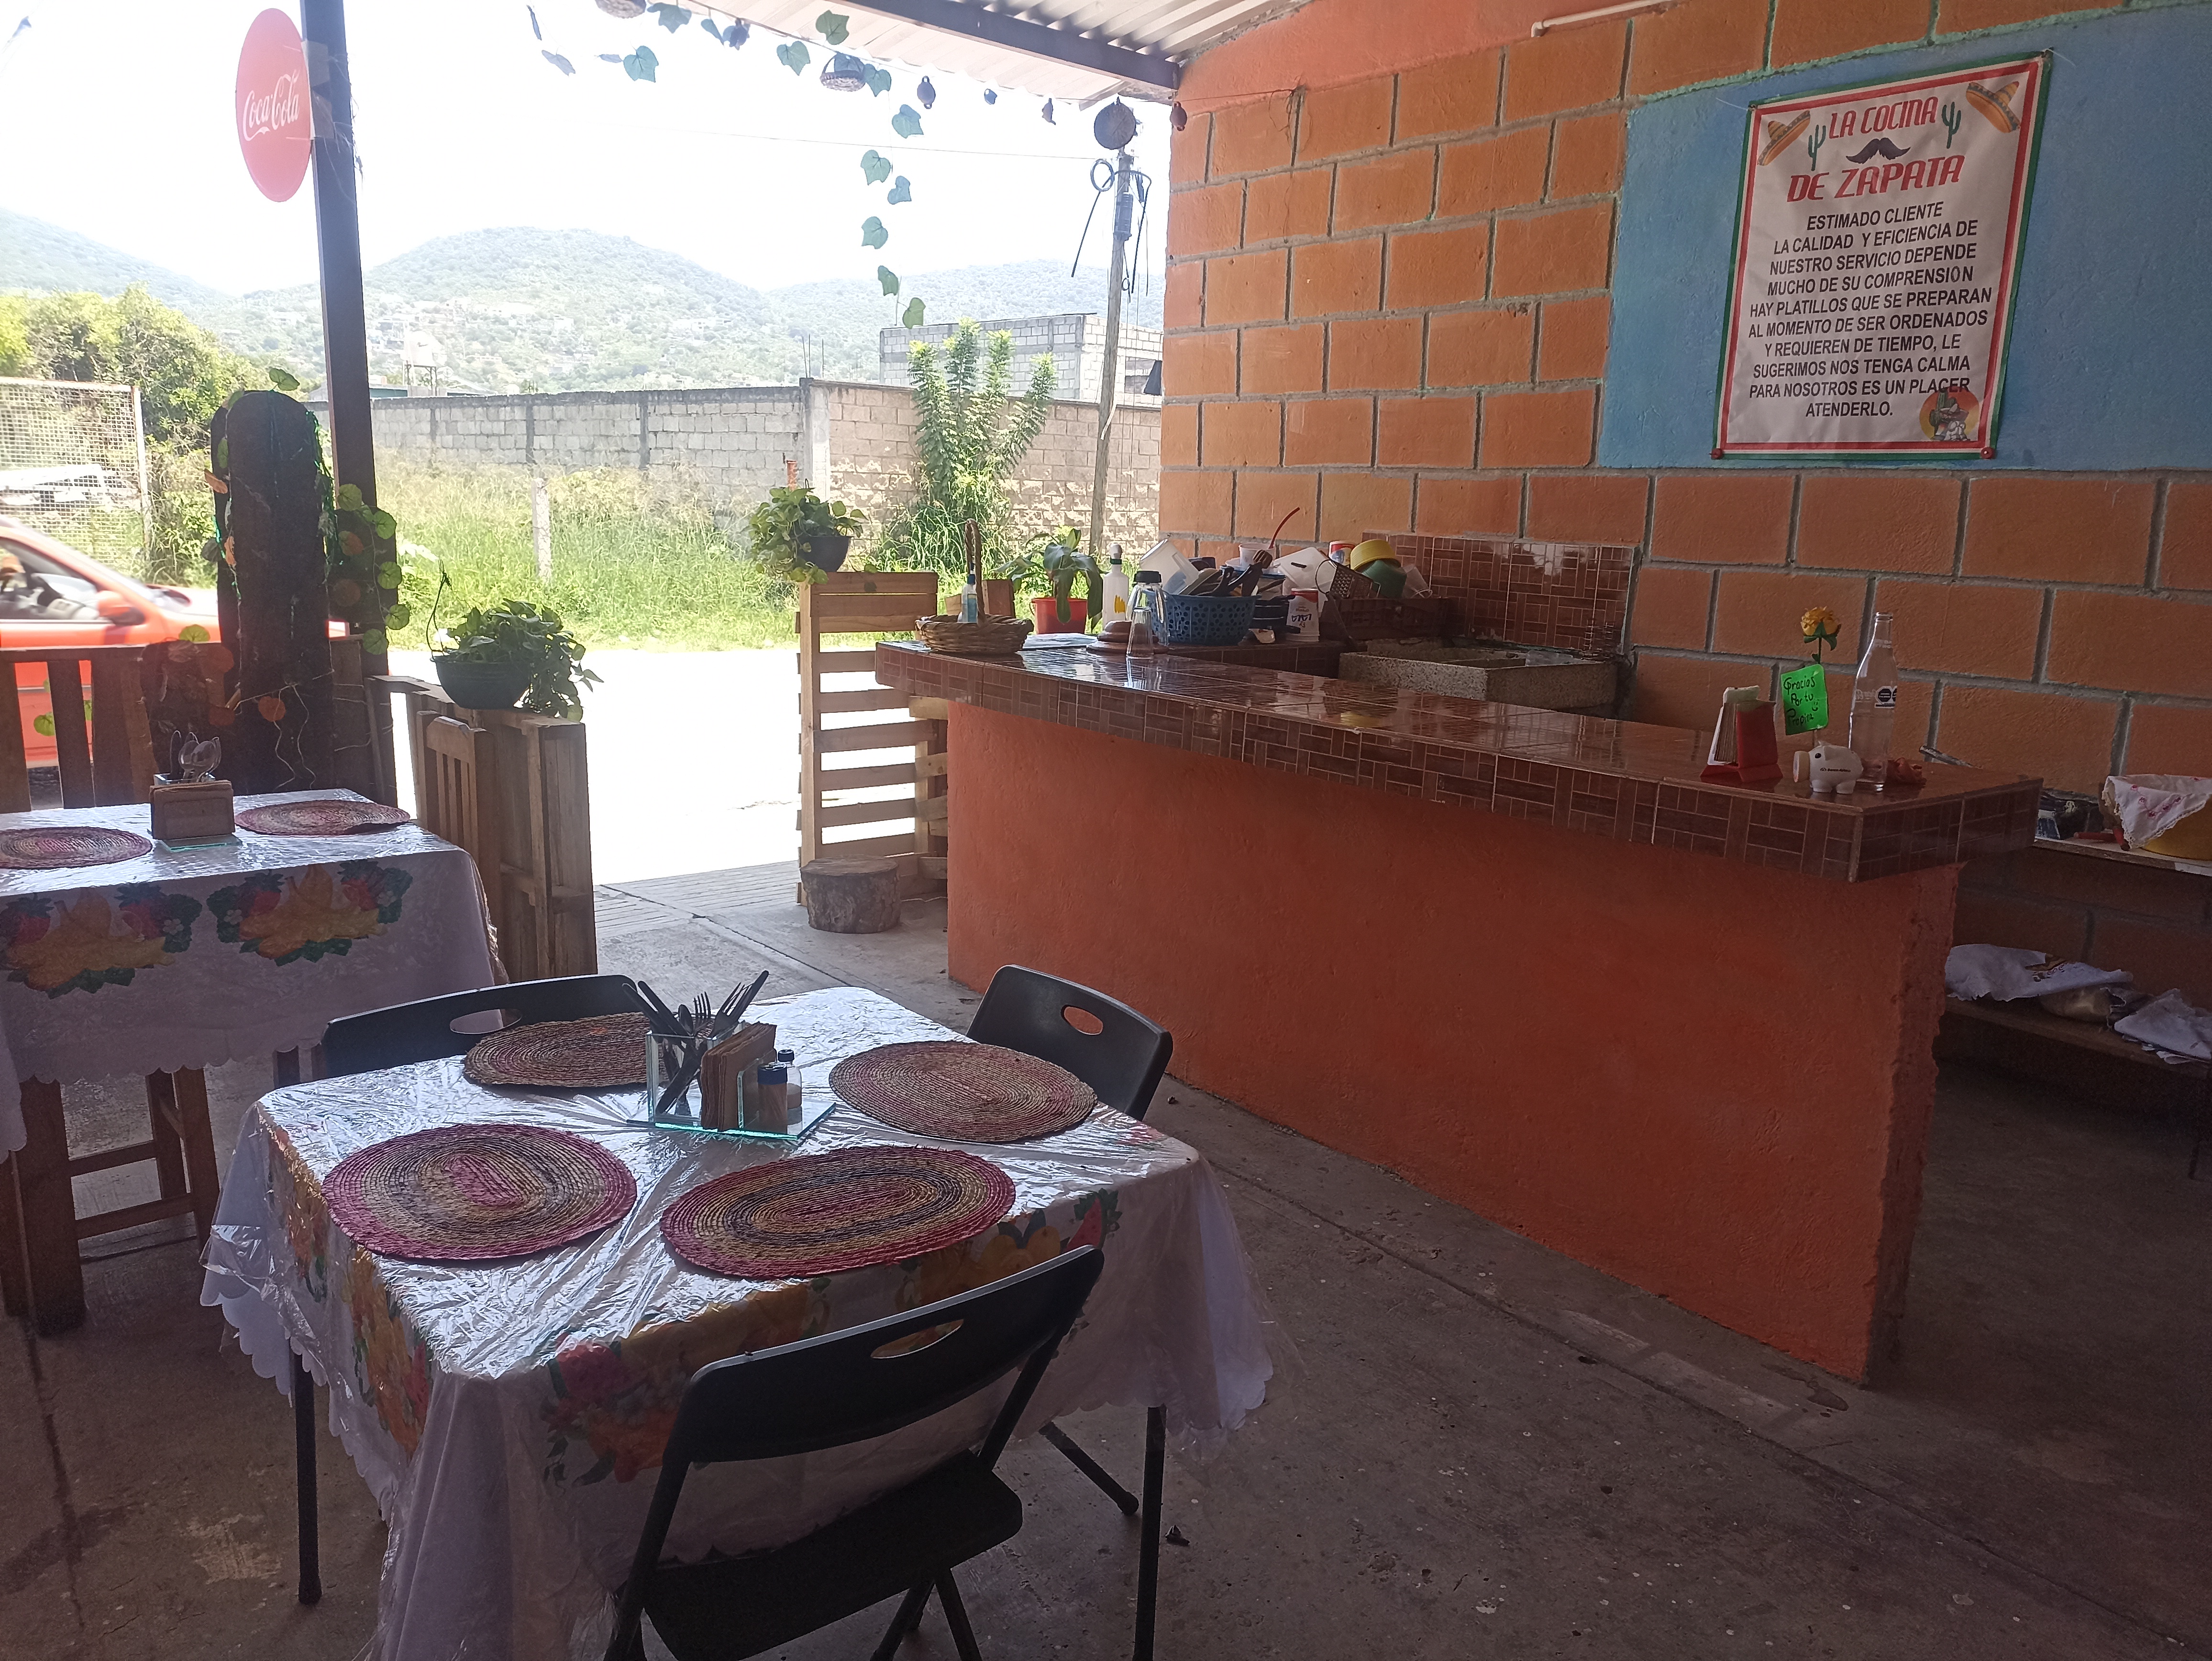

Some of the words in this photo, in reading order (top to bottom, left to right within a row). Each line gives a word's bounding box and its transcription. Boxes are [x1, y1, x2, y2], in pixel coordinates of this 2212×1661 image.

[1829, 110, 1857, 139] LA
[1860, 96, 1938, 134] COCINA
[1787, 172, 1830, 202] DE
[1834, 155, 1966, 199] ZAPATA
[1807, 210, 1880, 231] ESTIMADO
[1884, 201, 1944, 224] CLIENTE
[1774, 239, 1789, 255] LA
[1792, 234, 1854, 253] CALIDAD
[1862, 233, 1871, 247] Y
[1874, 222, 1951, 246] EFICIENCIA
[1956, 220, 1978, 237] DE
[1770, 256, 1833, 275] NUESTRO
[1836, 250, 1901, 271] SERVICIO
[1904, 243, 1977, 264] DEPENDE
[1767, 278, 1815, 296] MUCHO
[1819, 277, 1838, 292] DE
[1842, 276, 1861, 291] SU
[1864, 266, 1973, 289] COMPRENSION
[1750, 302, 1774, 318] HAY
[1776, 297, 1848, 316] PLATILLOS
[1851, 295, 1880, 311] QUE
[1883, 293, 1902, 309] SE
[1906, 287, 1992, 307] PREPARAN
[1748, 324, 1763, 338] AL
[1766, 319, 1832, 337] MOMENTO
[1835, 317, 1854, 332] DE
[1857, 315, 1885, 332] SER
[1890, 310, 1988, 330] ORDENADOS
[1765, 343, 1772, 357] Y
[1775, 338, 1850, 356] REQUIEREN
[1854, 337, 1873, 353] DE
[1878, 335, 1937, 352] TIEMPO,
[1942, 333, 1961, 349] LE
[1753, 361, 1826, 378] SUGERIMOS
[1830, 359, 1859, 375] NOS
[1864, 357, 1913, 374] TENGA
[1917, 355, 1970, 372] CALMA
[1749, 384, 1781, 398] PARA
[1783, 380, 1858, 397] NOSOTROS
[1861, 380, 1880, 395] ES
[1885, 379, 1905, 395] UN
[1909, 377, 1970, 394] PLACER
[1805, 401, 1893, 417] ATENDERLO.
[1783, 676, 1815, 695] Gracias
[1804, 690, 1814, 702] tu
